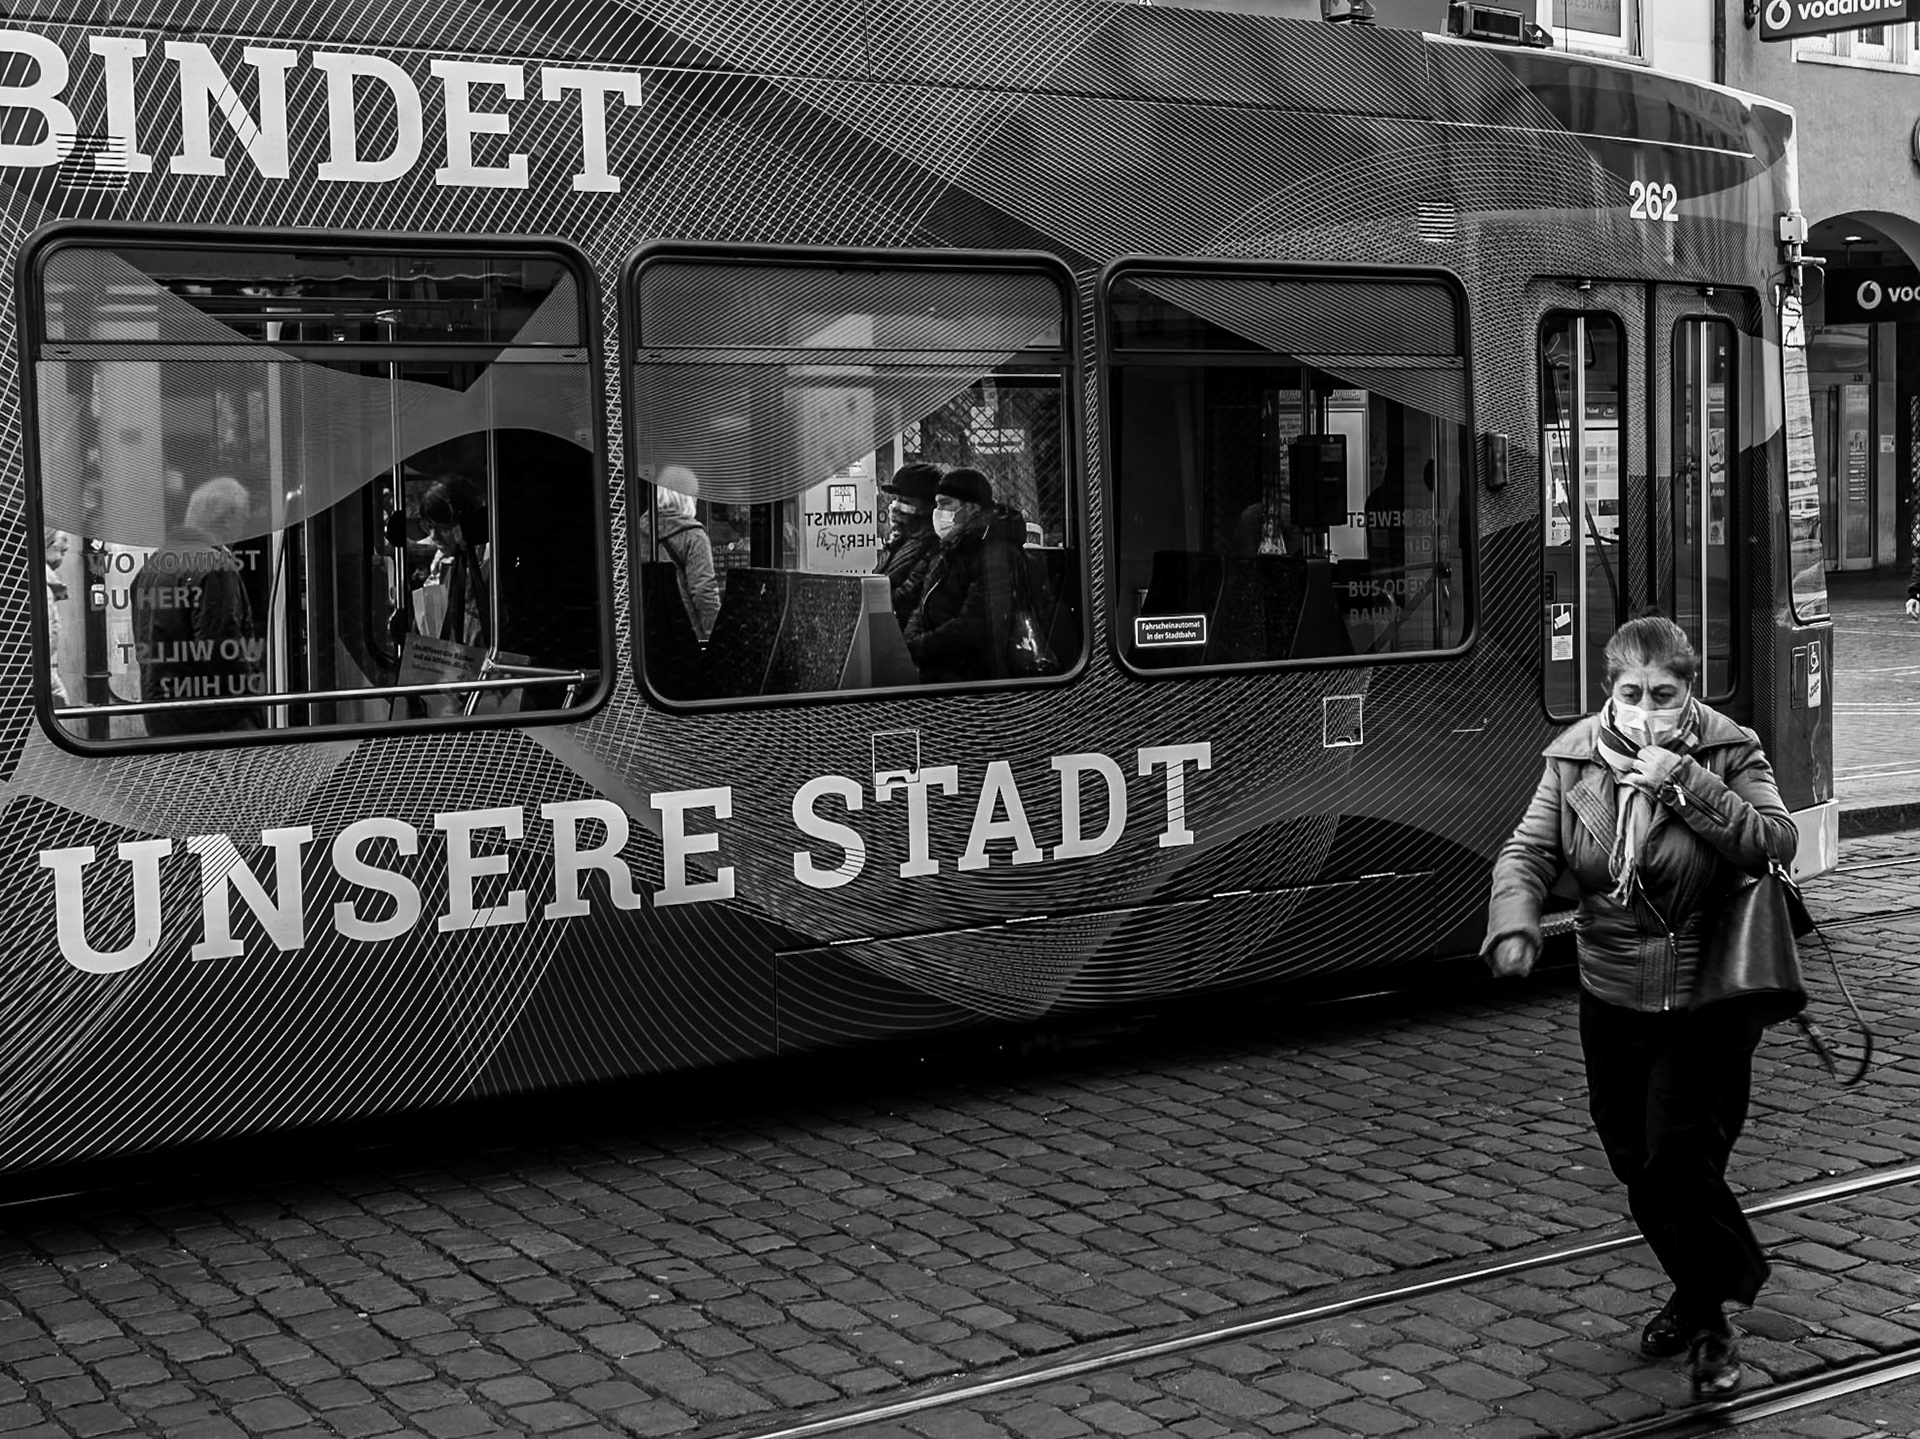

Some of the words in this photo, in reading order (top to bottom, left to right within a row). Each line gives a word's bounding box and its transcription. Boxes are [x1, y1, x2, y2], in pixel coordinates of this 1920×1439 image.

[0, 30, 641, 193] BINDET
[1630, 180, 1679, 221] 262
[87, 552, 135, 574] WO
[143, 550, 261, 574] KOMMST
[90, 588, 129, 611] DU
[137, 586, 203, 610] HER?
[1141, 621, 1200, 630] Fahrscheinautomat
[1154, 632, 1164, 640] der
[1165, 631, 1196, 640] Stadtbahn
[39, 786, 735, 975] UNSERE
[792, 741, 1213, 889] STADT
